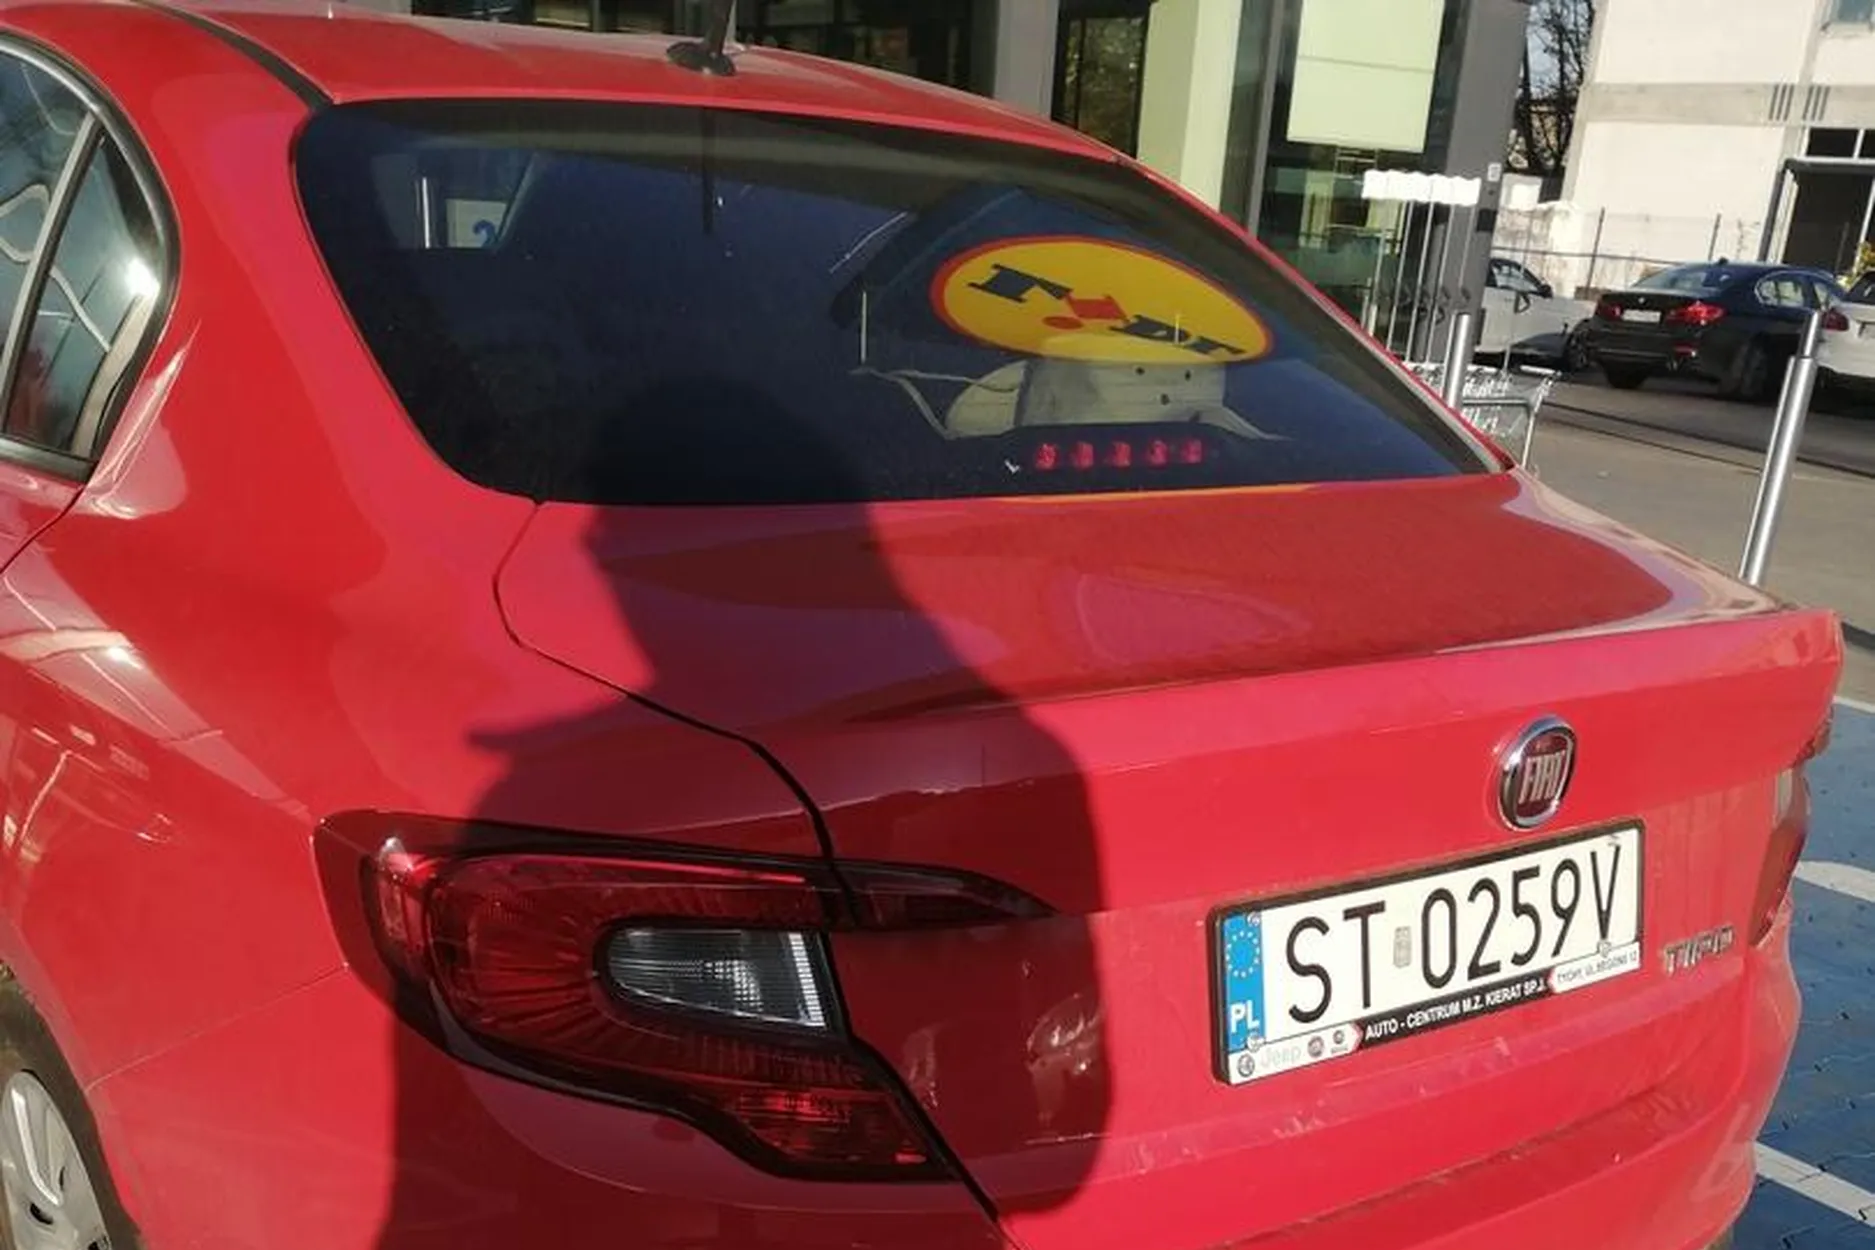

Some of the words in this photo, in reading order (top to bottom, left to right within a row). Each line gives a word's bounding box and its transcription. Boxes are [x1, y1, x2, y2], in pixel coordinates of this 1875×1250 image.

[1518, 749, 1567, 805] FIAT
[1286, 899, 1386, 1024] ST
[1420, 844, 1622, 990] 0259V
[1230, 999, 1260, 1034] PL
[1365, 1018, 1399, 1041] AUTO
[1406, 1001, 1461, 1029] CENTRUM
[1485, 983, 1522, 1007] KIERAT
